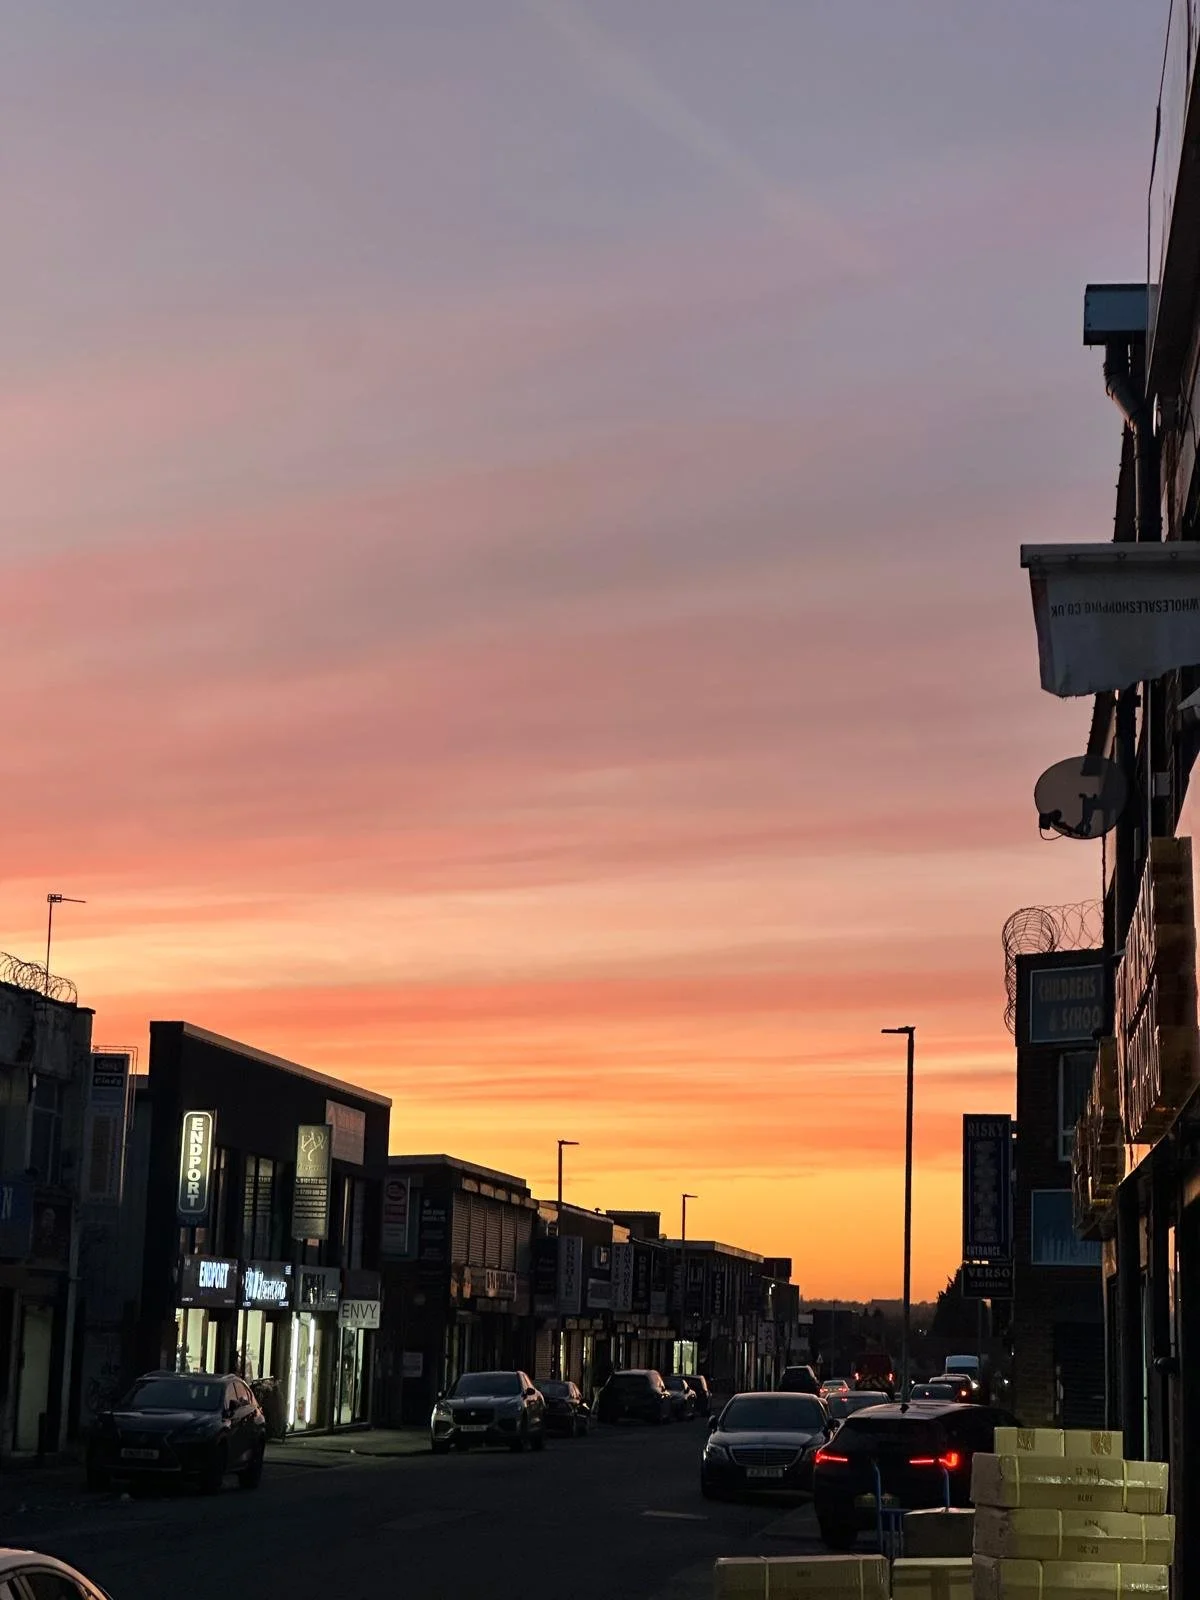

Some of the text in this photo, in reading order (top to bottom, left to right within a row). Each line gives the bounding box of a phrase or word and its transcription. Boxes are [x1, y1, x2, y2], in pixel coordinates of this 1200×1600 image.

[967, 1121, 1005, 1138] RISKY
[187, 1117, 204, 1208] ENDPORT
[966, 1245, 1001, 1257] ENTRANCE
[199, 1260, 230, 1289] ENDPORT
[967, 1267, 1011, 1279] VERSO
[342, 1302, 378, 1319] ENVY
